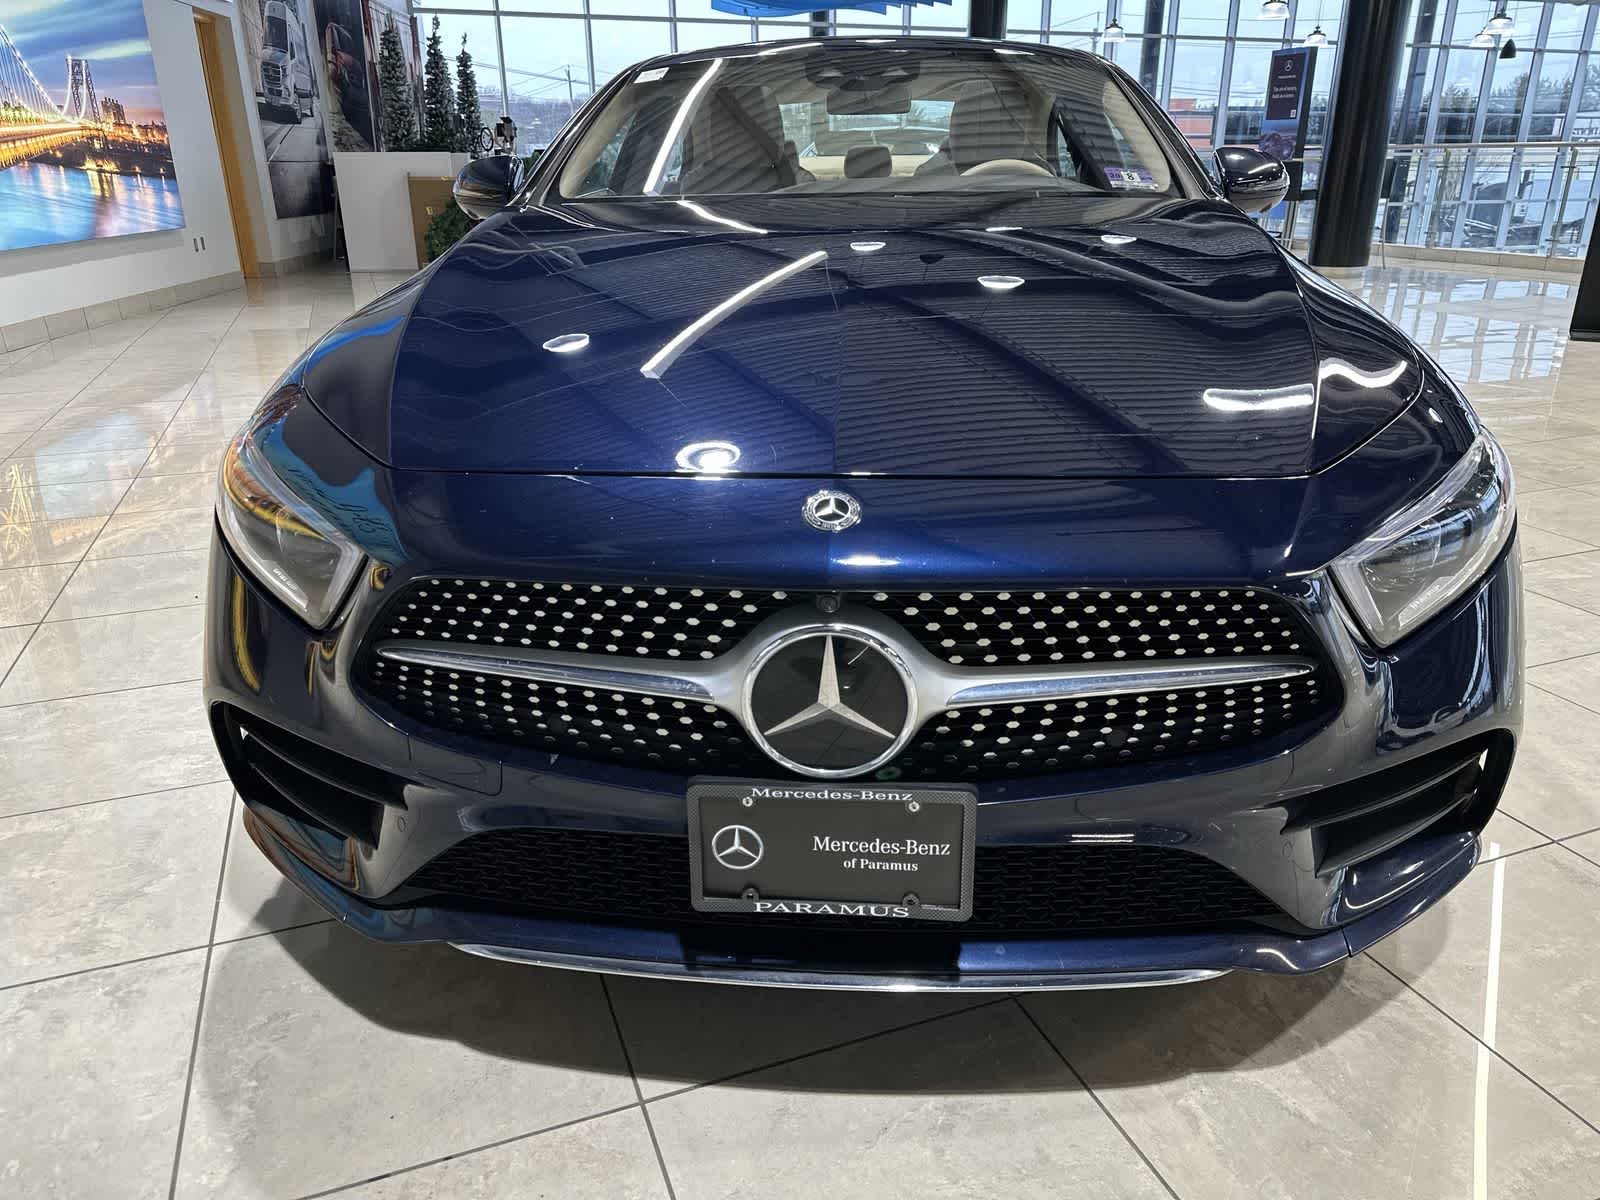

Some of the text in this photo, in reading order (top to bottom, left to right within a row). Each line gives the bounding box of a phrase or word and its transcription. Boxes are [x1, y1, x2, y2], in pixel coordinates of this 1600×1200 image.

[751, 787, 913, 801] Mercedes-Benz
[812, 835, 951, 856] Mercedes-Benz
[843, 857, 919, 872] of Paramus
[753, 901, 910, 918] PARAMUS
